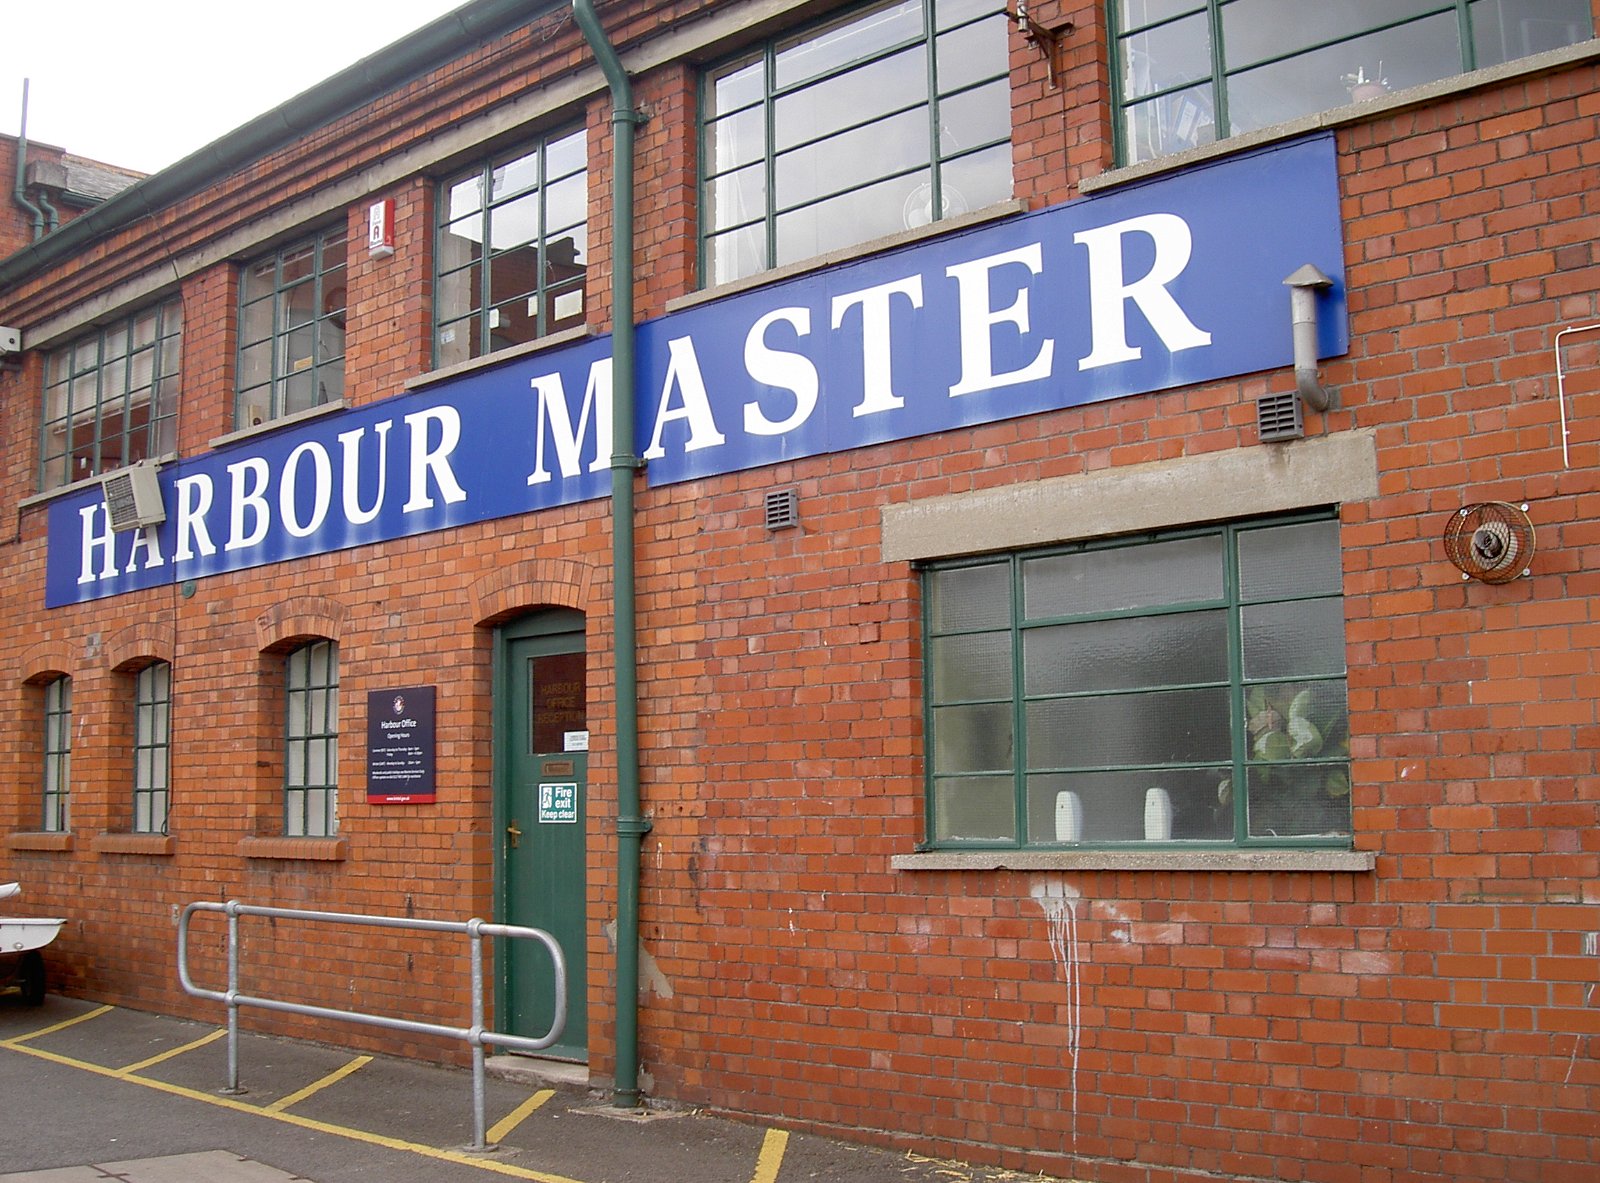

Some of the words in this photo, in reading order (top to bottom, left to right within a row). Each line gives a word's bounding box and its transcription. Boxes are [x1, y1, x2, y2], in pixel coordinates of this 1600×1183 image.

[78, 405, 467, 585] HARBOUR
[527, 213, 1211, 486] MASTER
[381, 720, 401, 729] Harbour
[401, 718, 417, 728] Office
[555, 787, 572, 798] Fire
[555, 798, 571, 809] exit
[541, 810, 558, 820] Keep
[558, 810, 575, 819] clear
